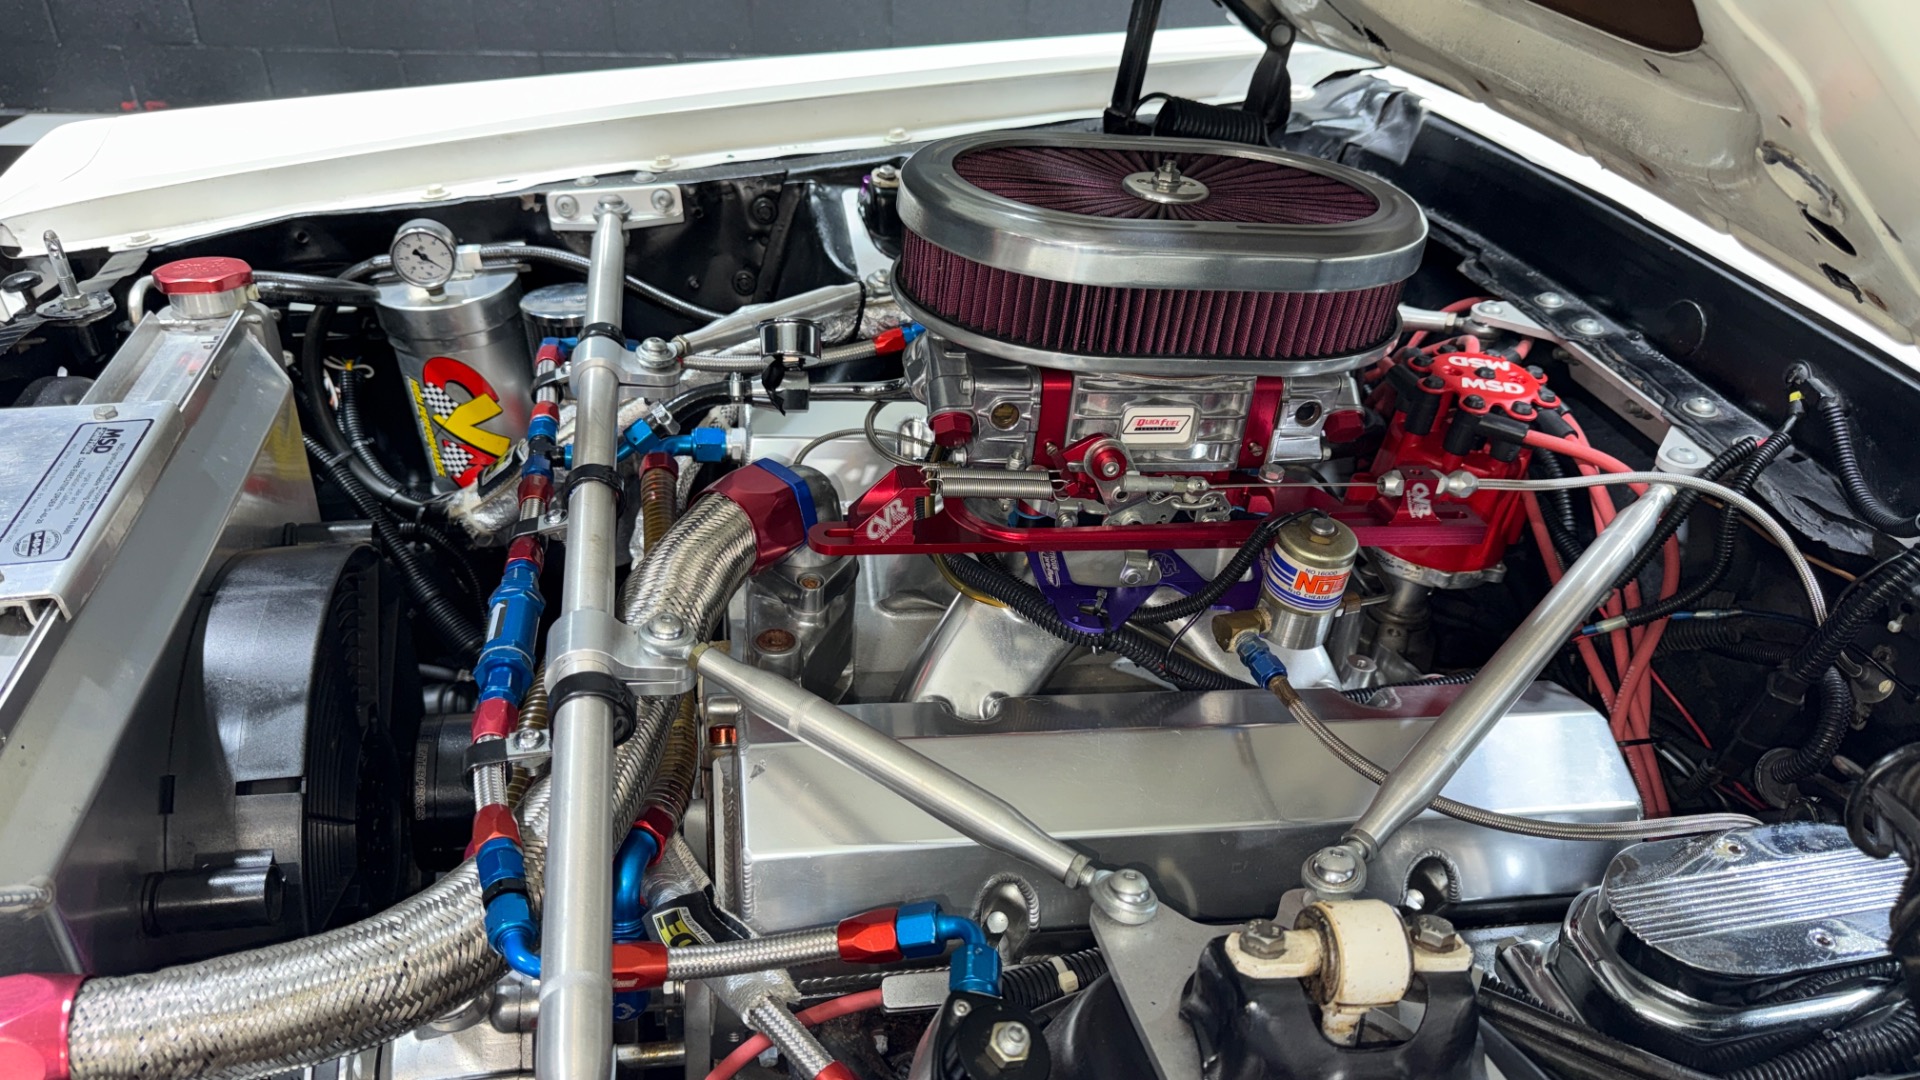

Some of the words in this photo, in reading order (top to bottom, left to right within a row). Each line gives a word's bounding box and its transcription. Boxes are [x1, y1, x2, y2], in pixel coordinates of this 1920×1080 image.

[1448, 356, 1511, 371] MSD
[1461, 377, 1526, 394] MSD
[93, 429, 123, 453] MSD
[409, 379, 425, 403] HIGH
[417, 405, 446, 478] PERFORMANCE
[866, 498, 909, 540] CVR
[1294, 570, 1351, 595] NOS
[415, 743, 429, 821] ENTERPRISES
